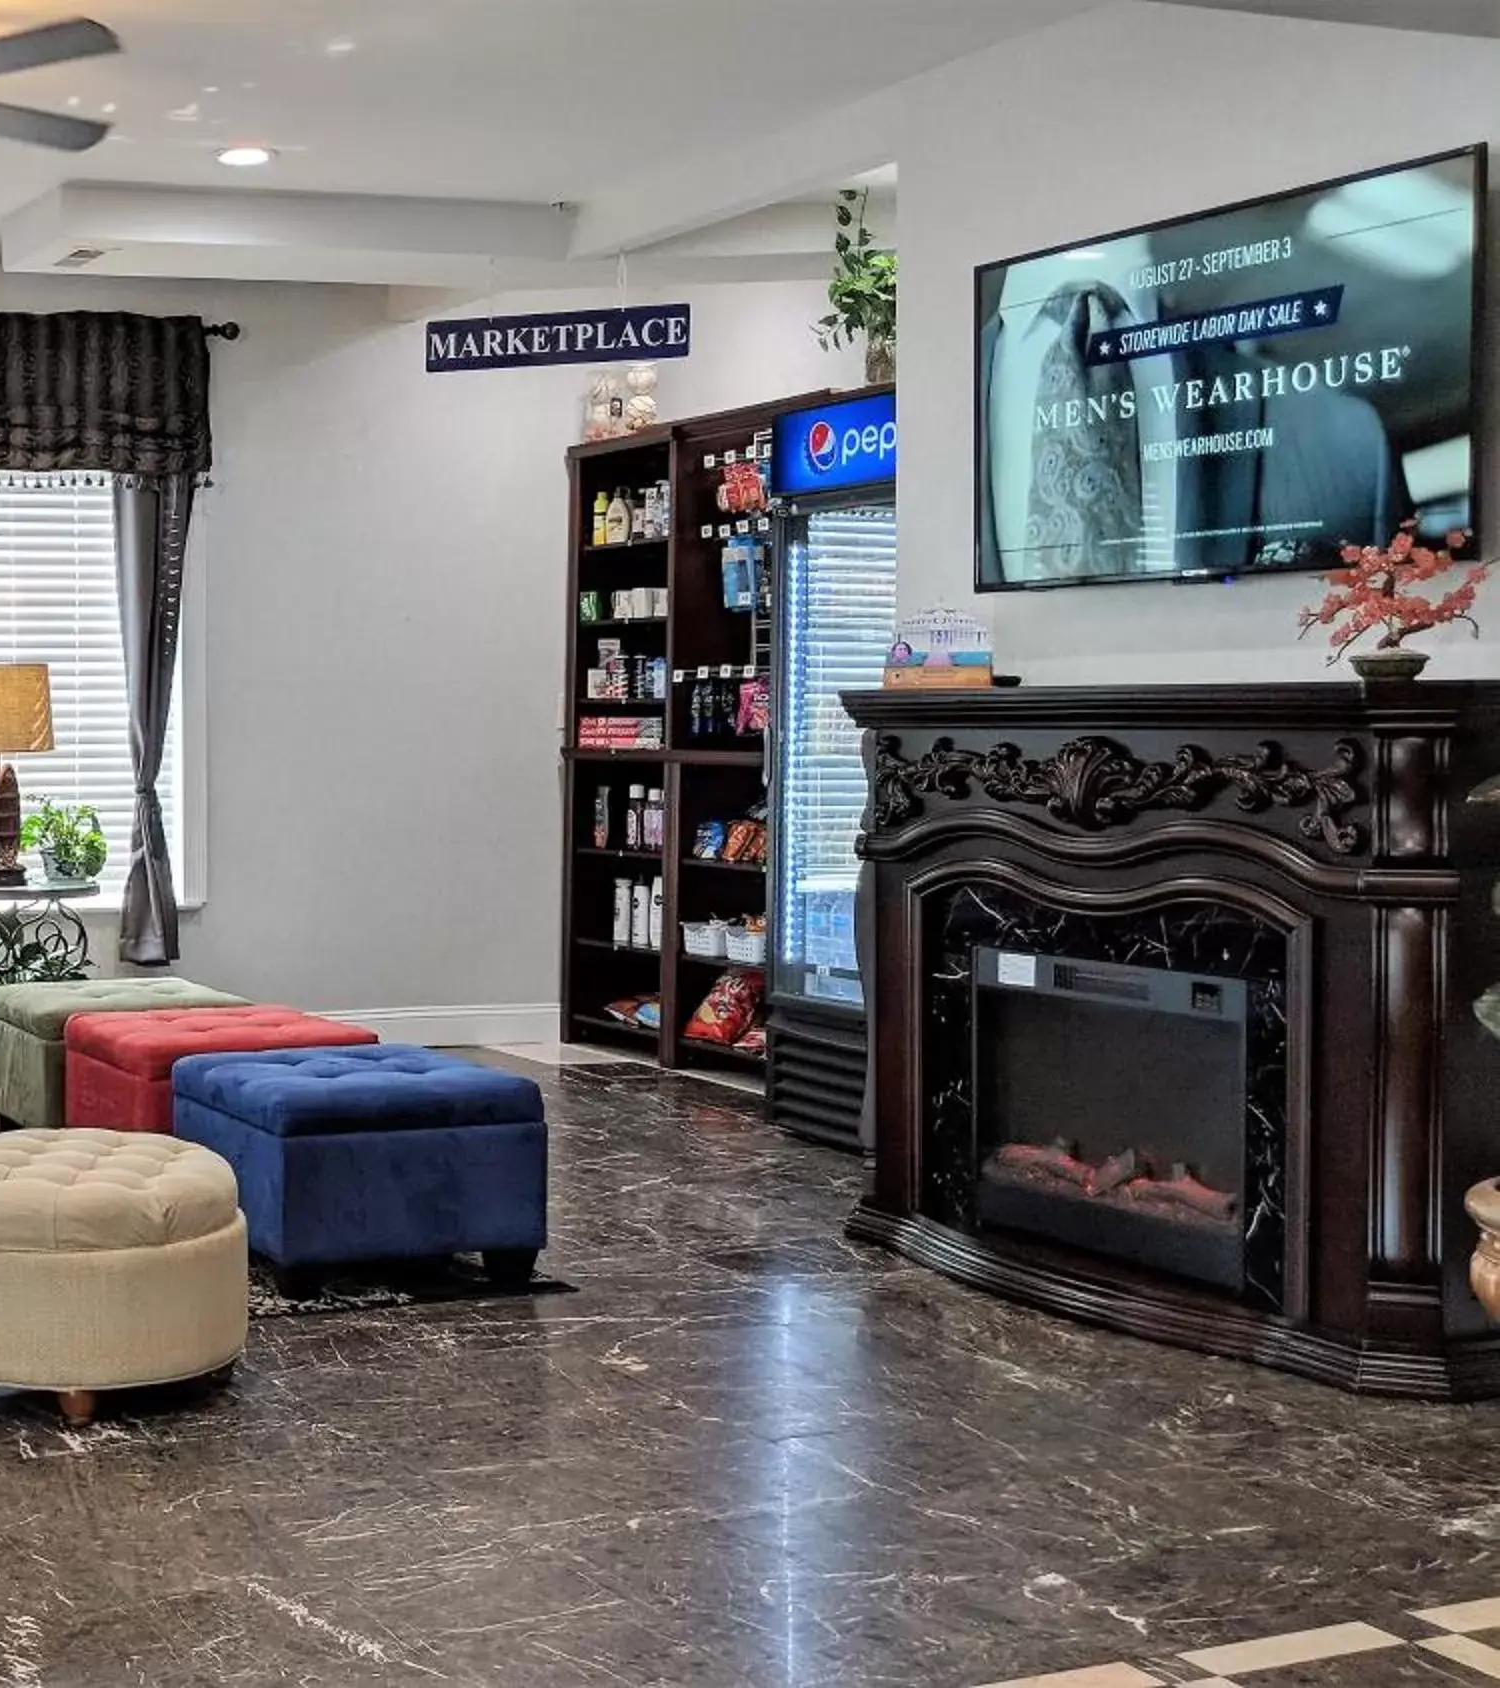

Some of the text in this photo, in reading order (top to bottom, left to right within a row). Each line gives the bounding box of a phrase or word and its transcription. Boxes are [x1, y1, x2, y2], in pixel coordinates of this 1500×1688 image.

[1130, 261, 1177, 290] AUGUST
[1178, 257, 1194, 282] 27
[1202, 238, 1280, 275] SEPTEMBER
[1282, 236, 1292, 259] 3
[429, 317, 687, 361] MARKETPLACE
[1119, 300, 1302, 354] STOREWIDE LABOR DAY SALE
[1034, 390, 1137, 430] MEN'S
[1143, 427, 1274, 462] MENSWEARHOUSE.COM
